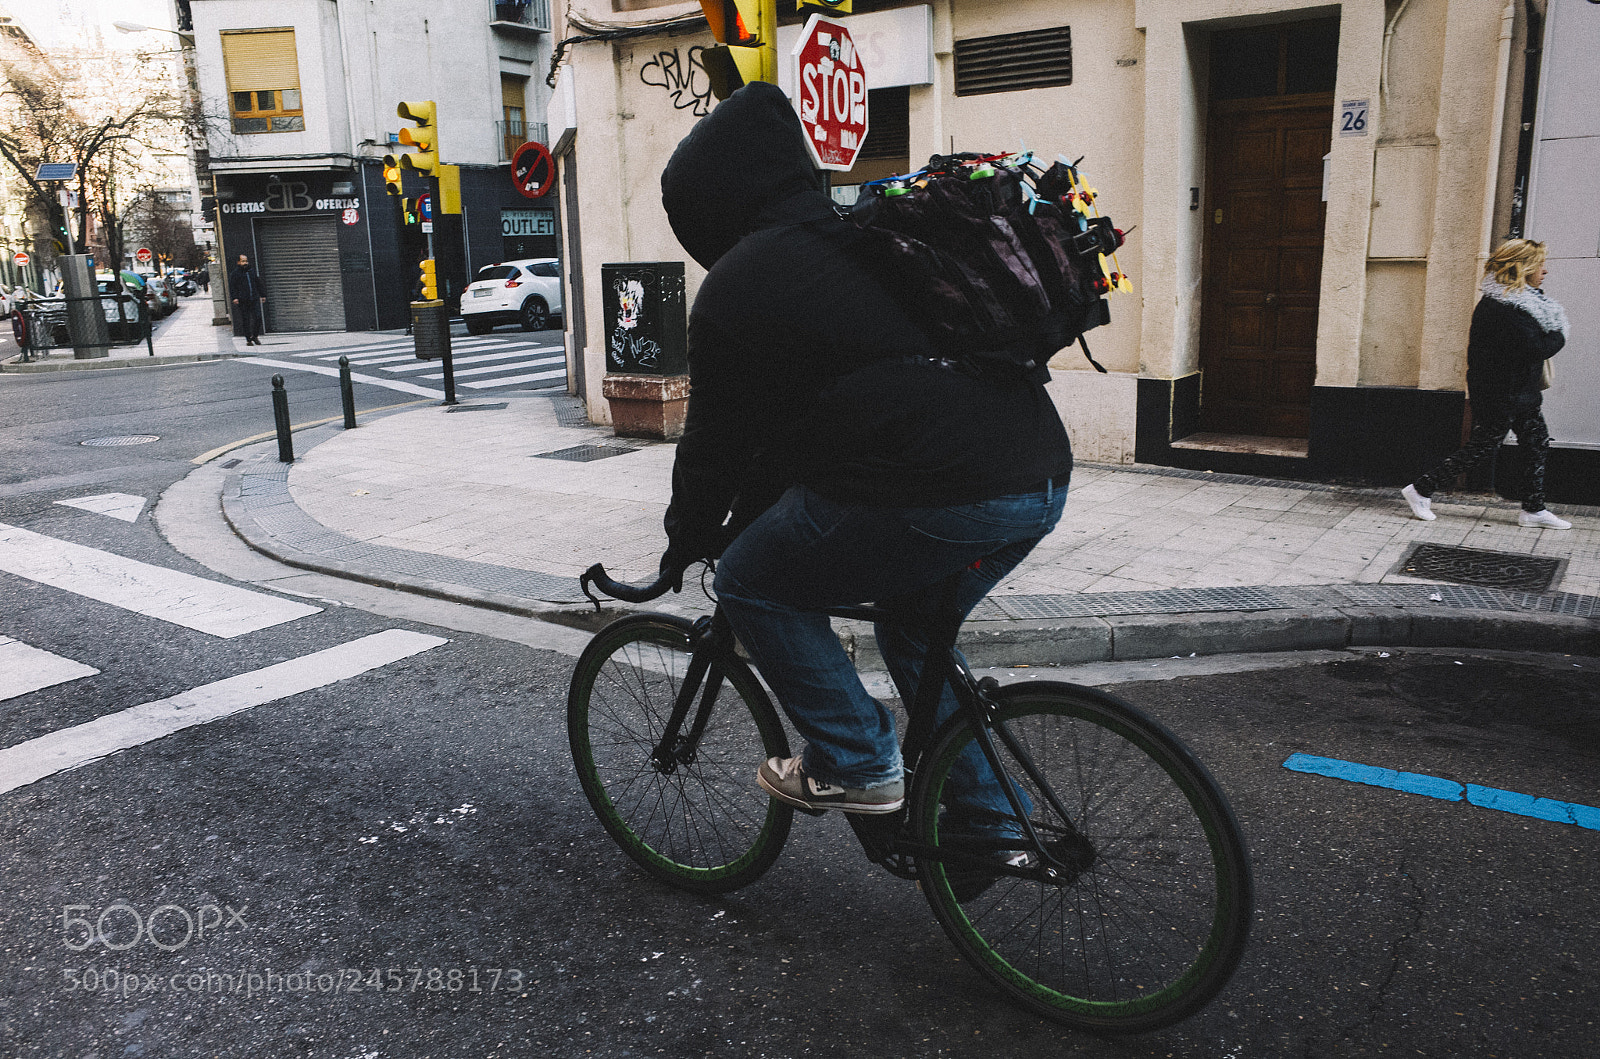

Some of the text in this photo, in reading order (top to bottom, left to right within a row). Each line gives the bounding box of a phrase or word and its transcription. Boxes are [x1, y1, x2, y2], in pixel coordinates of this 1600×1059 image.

[803, 63, 864, 125] STOP
[1342, 110, 1365, 131] 26
[222, 202, 266, 214] OFERTAS
[315, 197, 360, 210] OFERTAS
[502, 219, 553, 234] OUTLET
